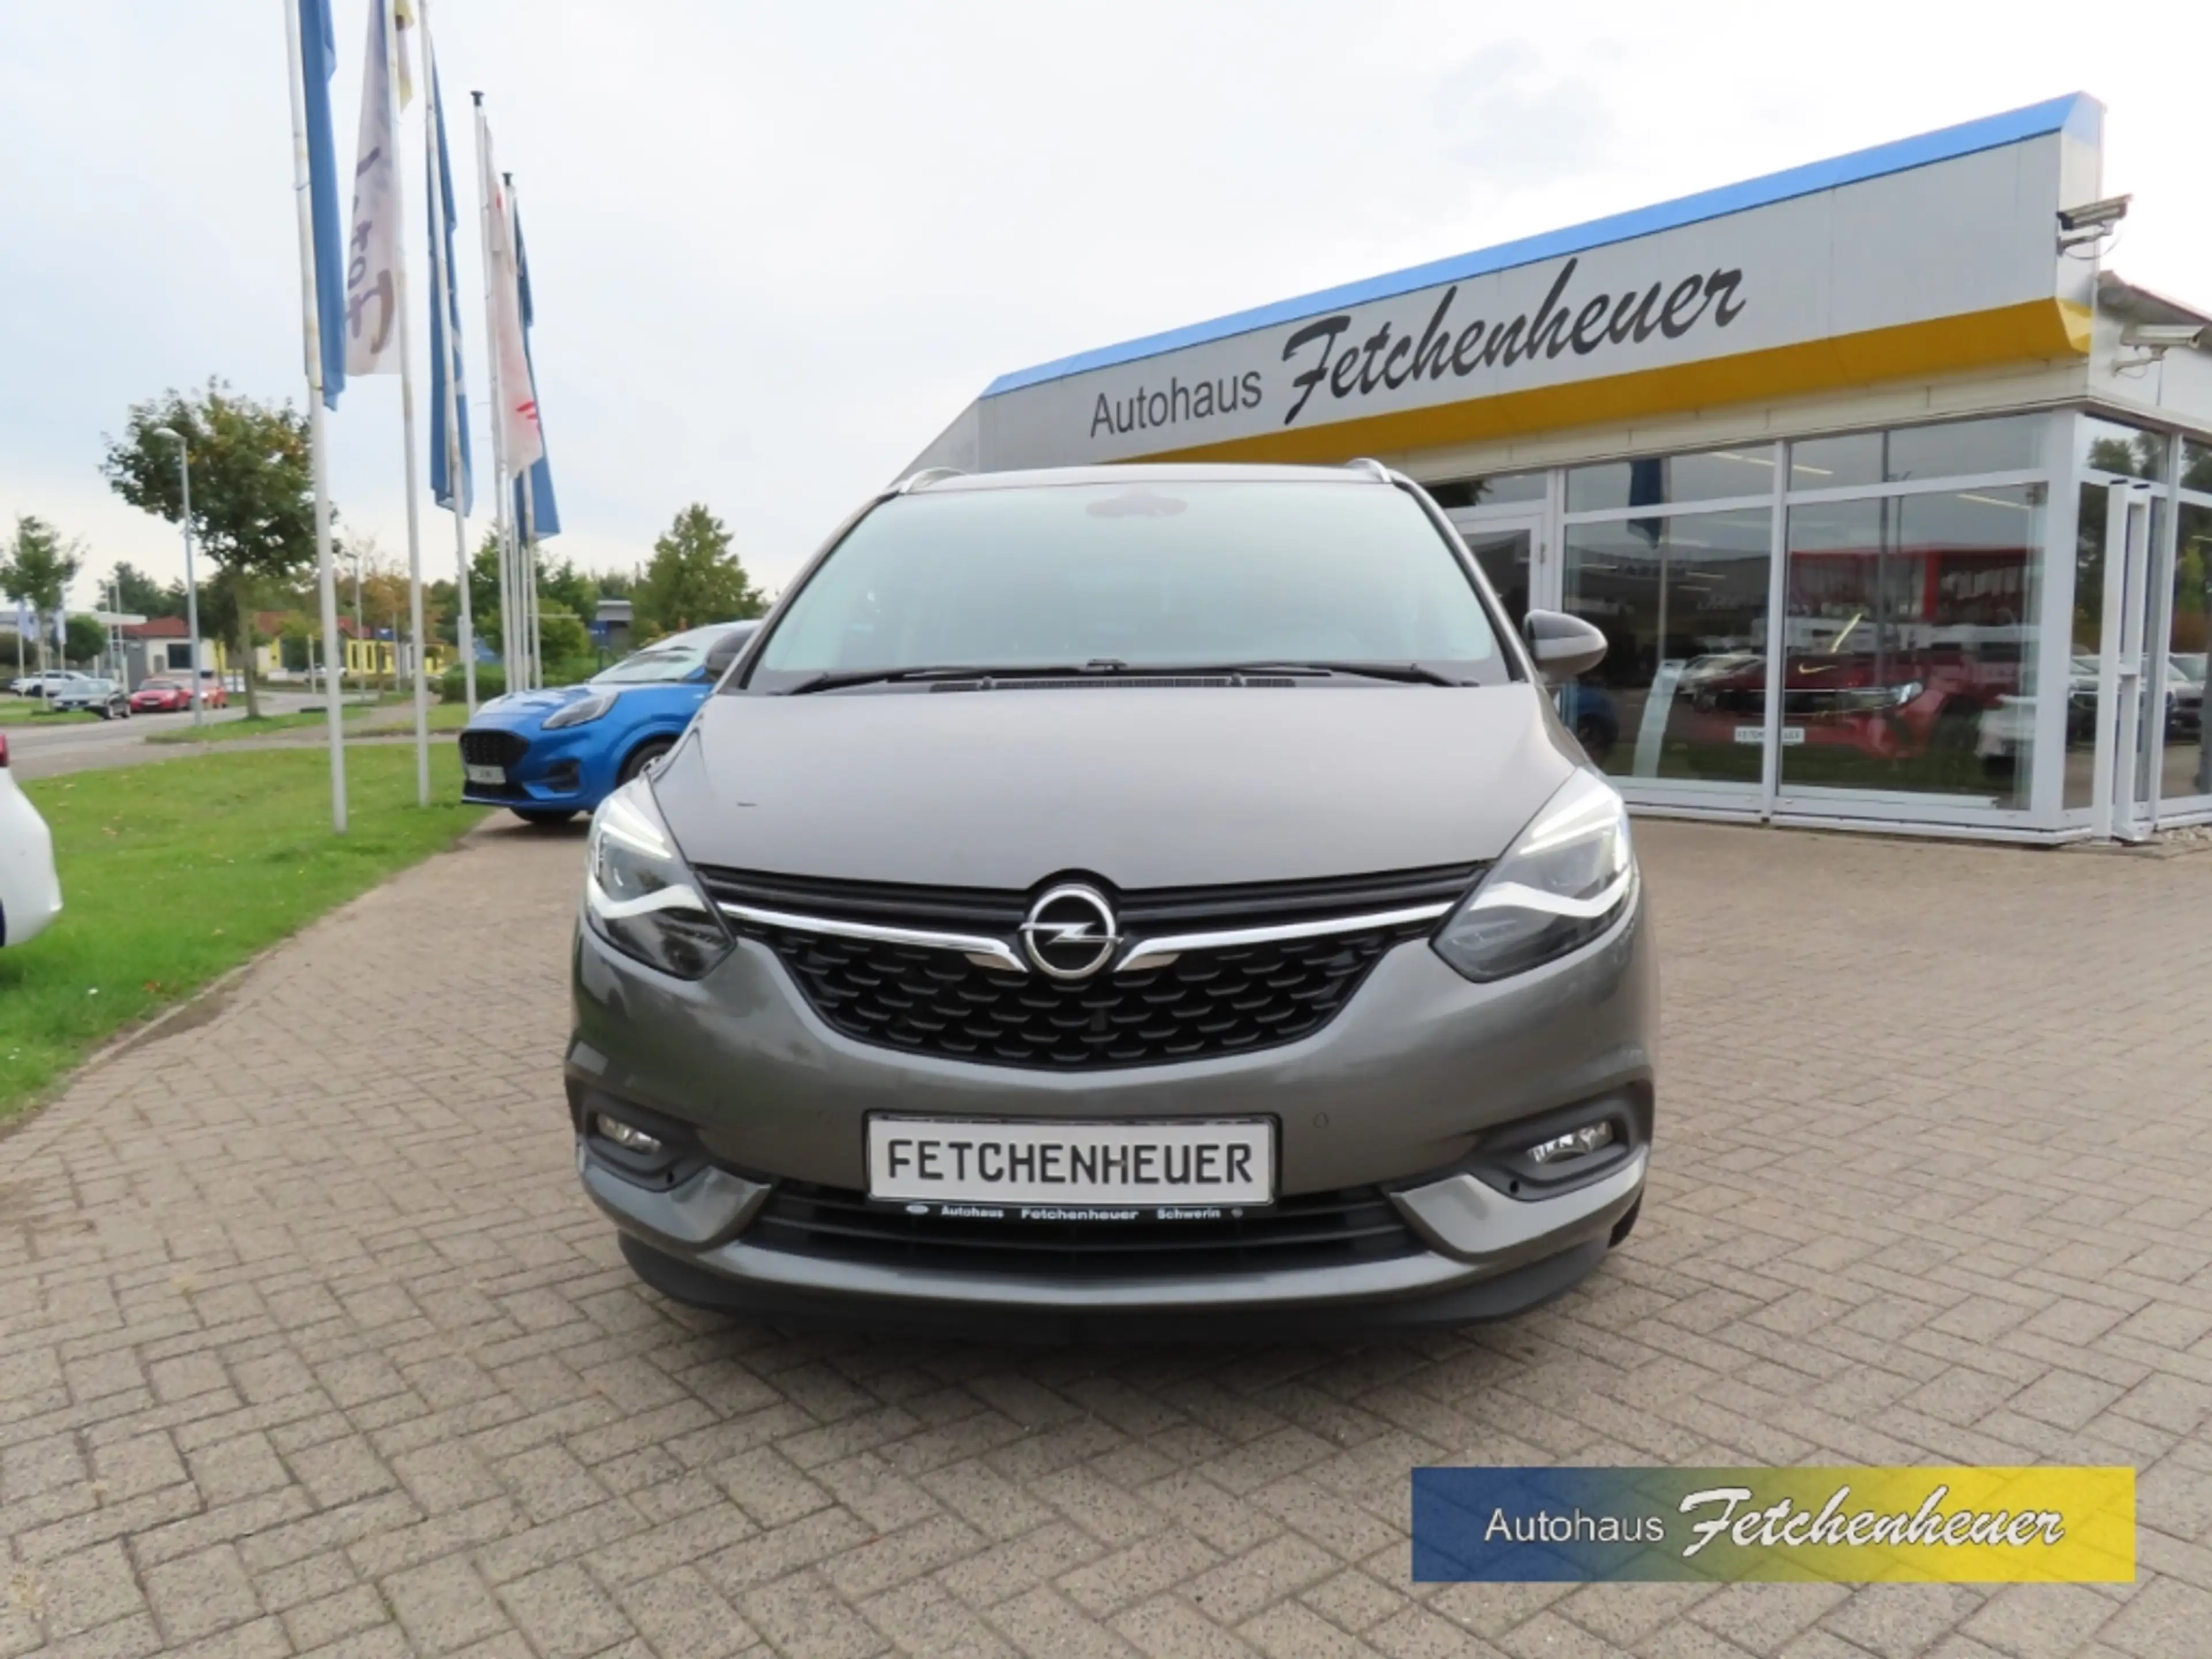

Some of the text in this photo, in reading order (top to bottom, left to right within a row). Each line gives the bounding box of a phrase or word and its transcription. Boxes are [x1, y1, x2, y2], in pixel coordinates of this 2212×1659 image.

[1090, 256, 1747, 438] Autohaus Fetchenheuer
[888, 1139, 1253, 1184] FETCHENHEUER
[941, 1205, 1004, 1219] Autohaus
[1157, 1207, 1222, 1221] Schwerin
